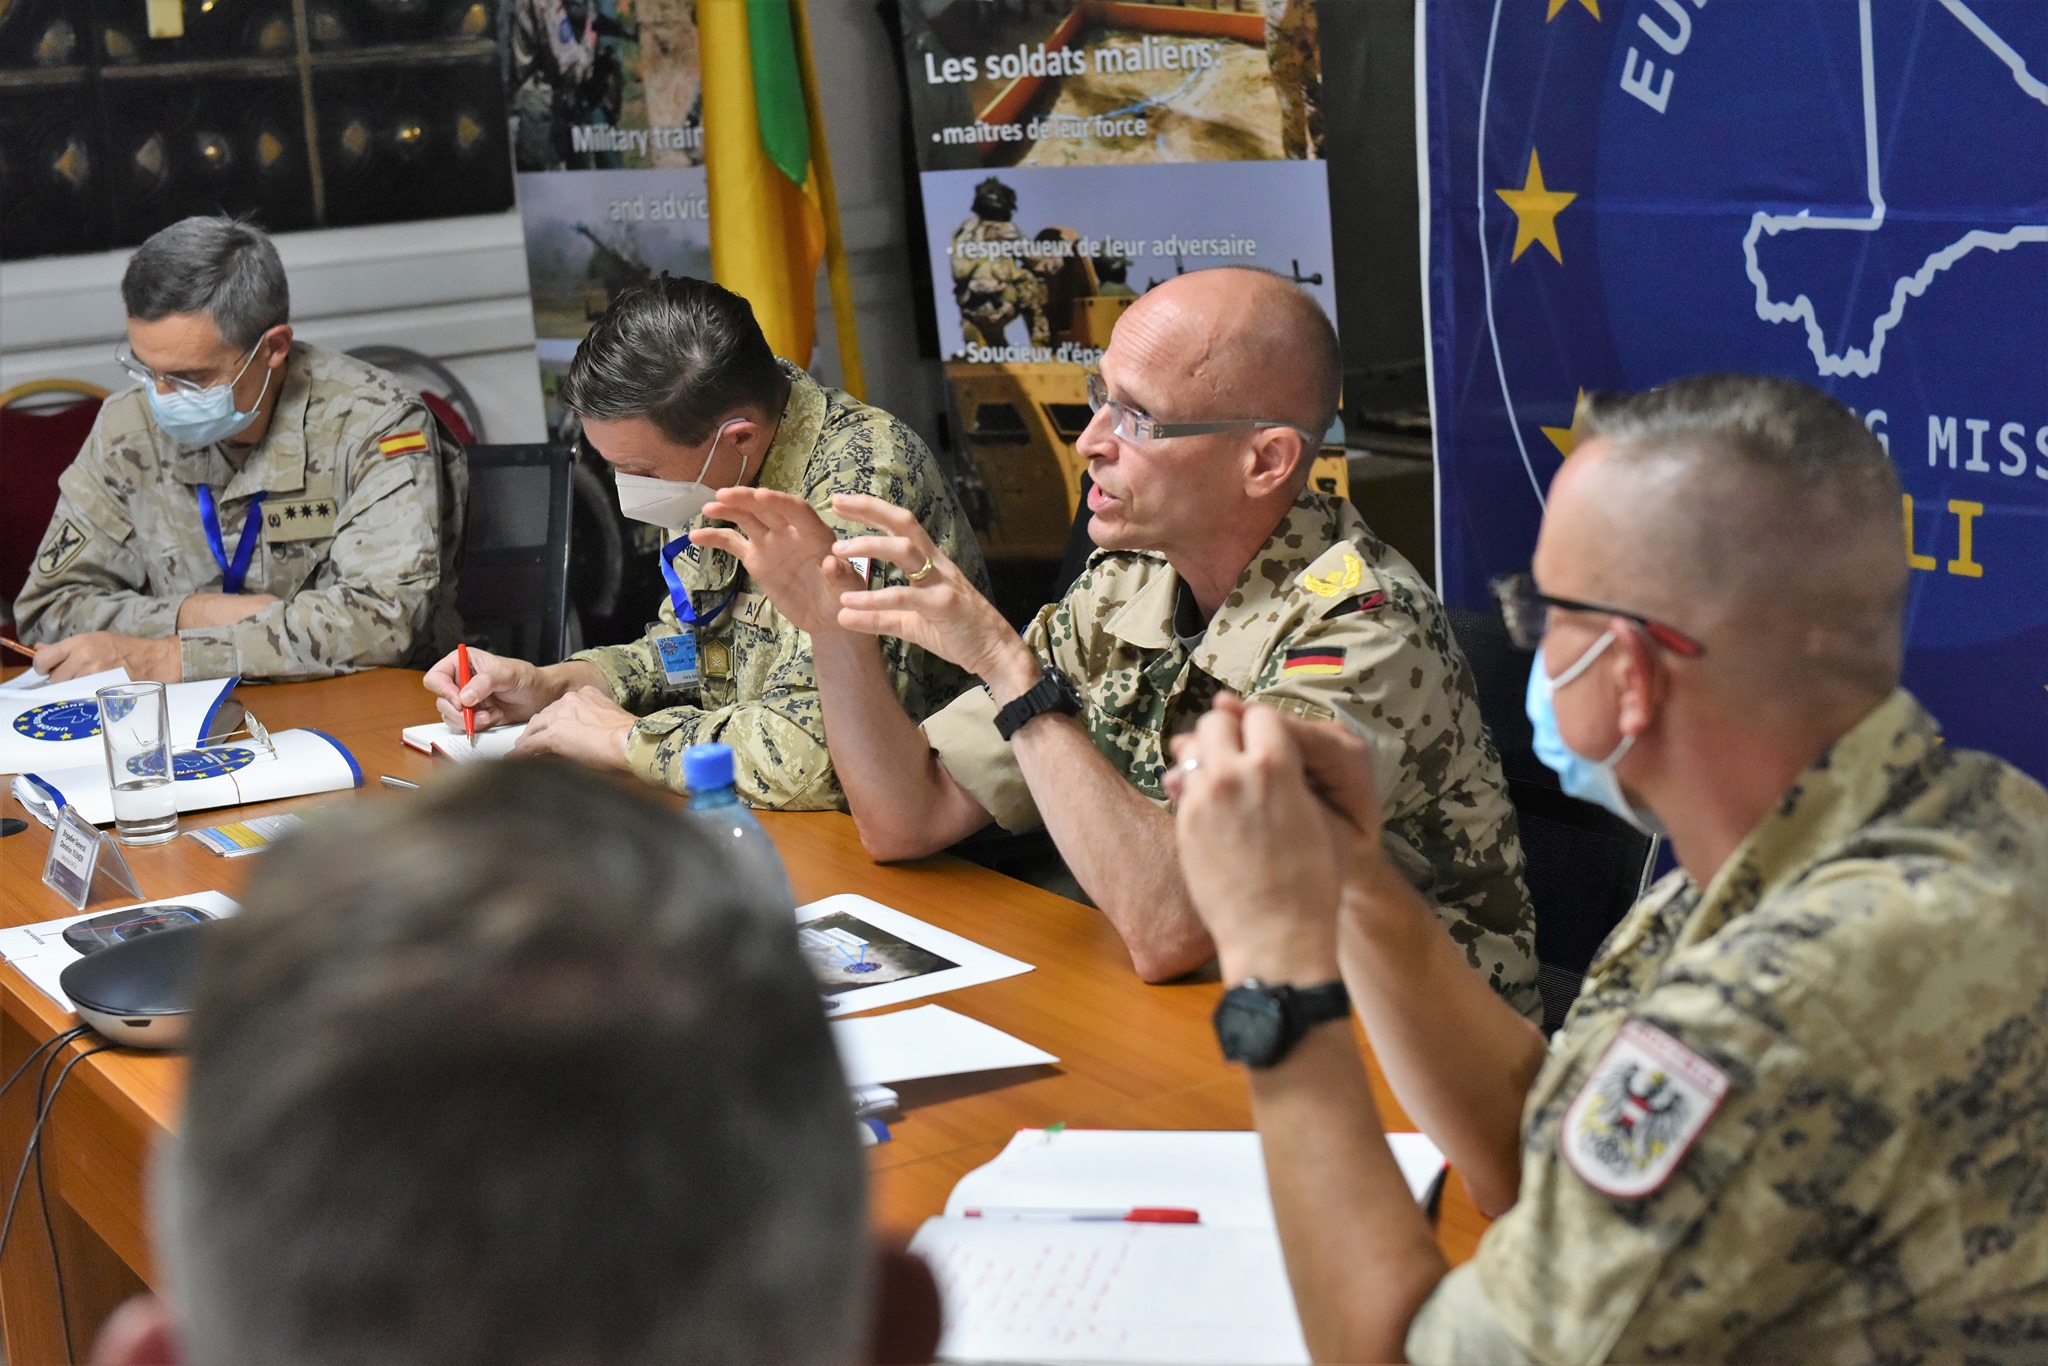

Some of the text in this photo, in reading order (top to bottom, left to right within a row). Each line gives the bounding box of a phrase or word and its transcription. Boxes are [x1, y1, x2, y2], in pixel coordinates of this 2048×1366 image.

[925, 52, 978, 84] Les
[985, 43, 1087, 80] soldats
[1620, 0, 1707, 114] EU
[571, 123, 648, 158] Military
[1026, 115, 1050, 140] de
[1053, 115, 1091, 138] leur
[1094, 114, 1147, 138] force
[609, 194, 646, 221] and
[956, 233, 1257, 262] respectueux de leur adversaire
[966, 341, 1053, 365] Soucieux
